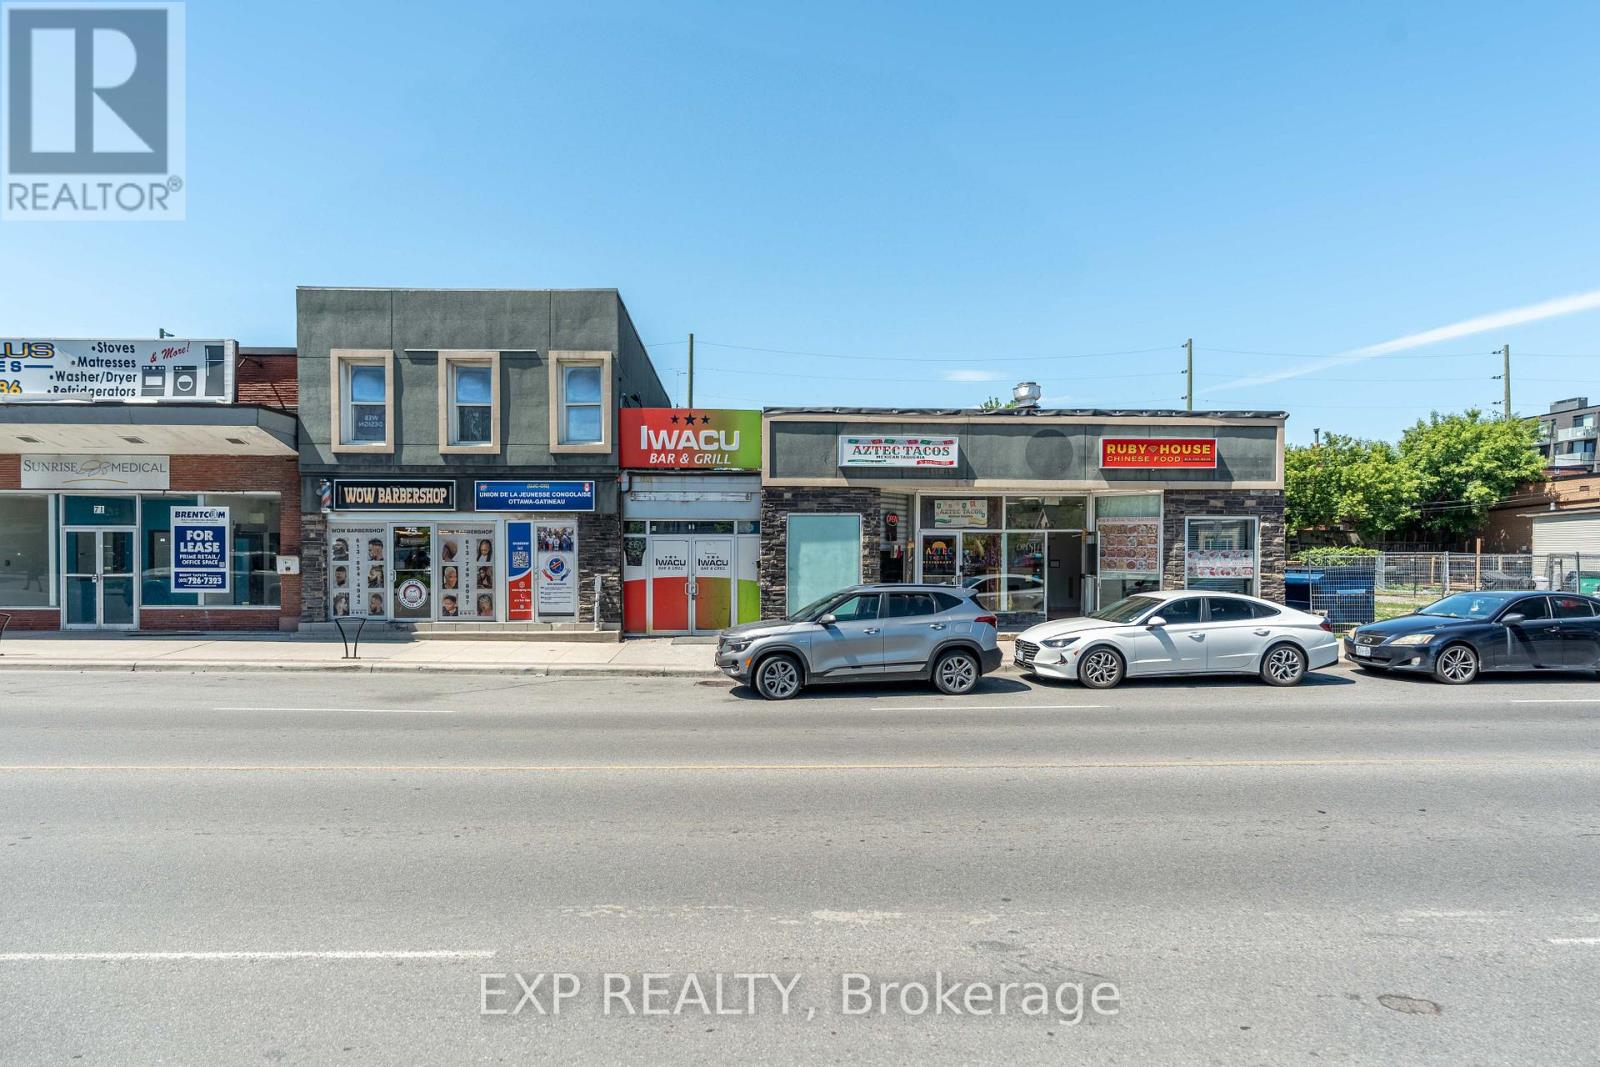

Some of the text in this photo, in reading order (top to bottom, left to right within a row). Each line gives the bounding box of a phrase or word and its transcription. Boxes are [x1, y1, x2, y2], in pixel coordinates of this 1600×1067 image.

[97, 342, 135, 353] Stoves
[150, 341, 191, 363] & More!
[77, 356, 137, 368] Matresses
[55, 370, 137, 385] Washer/Dryer
[640, 425, 740, 450] IWACU
[852, 445, 950, 456] AZTEC TACOS
[1106, 444, 1211, 455] RUBY HOUSE
[649, 453, 732, 464] BAR & GRILL
[23, 459, 167, 473] SUNRISE MEDICAL
[344, 486, 448, 504] WOW BARBERSHOP
[186, 530, 214, 541] FOR
[405, 527, 418, 535] 75
[180, 541, 220, 553] LEASE
[925, 546, 954, 556] AZTEC
[655, 558, 686, 566] IWACU
[698, 558, 728, 566] IWACU
